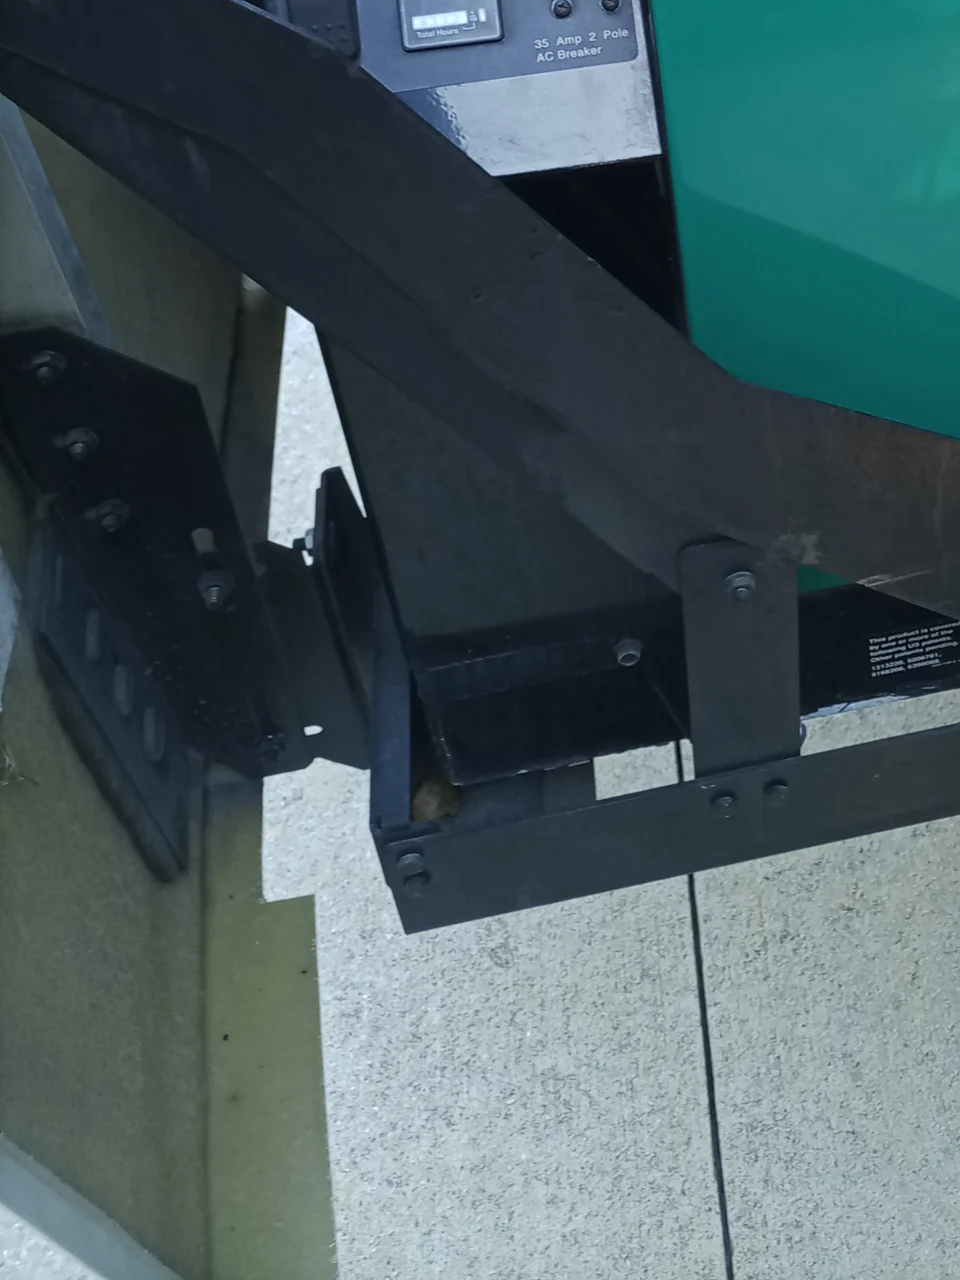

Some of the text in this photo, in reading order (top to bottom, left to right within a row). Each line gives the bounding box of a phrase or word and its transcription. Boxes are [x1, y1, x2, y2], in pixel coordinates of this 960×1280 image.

[417, 28, 460, 39] Total Hours
[534, 28, 629, 50] 35 Amp 2 Pole
[536, 45, 603, 63] AC Breaker
[887, 629, 920, 641] product
